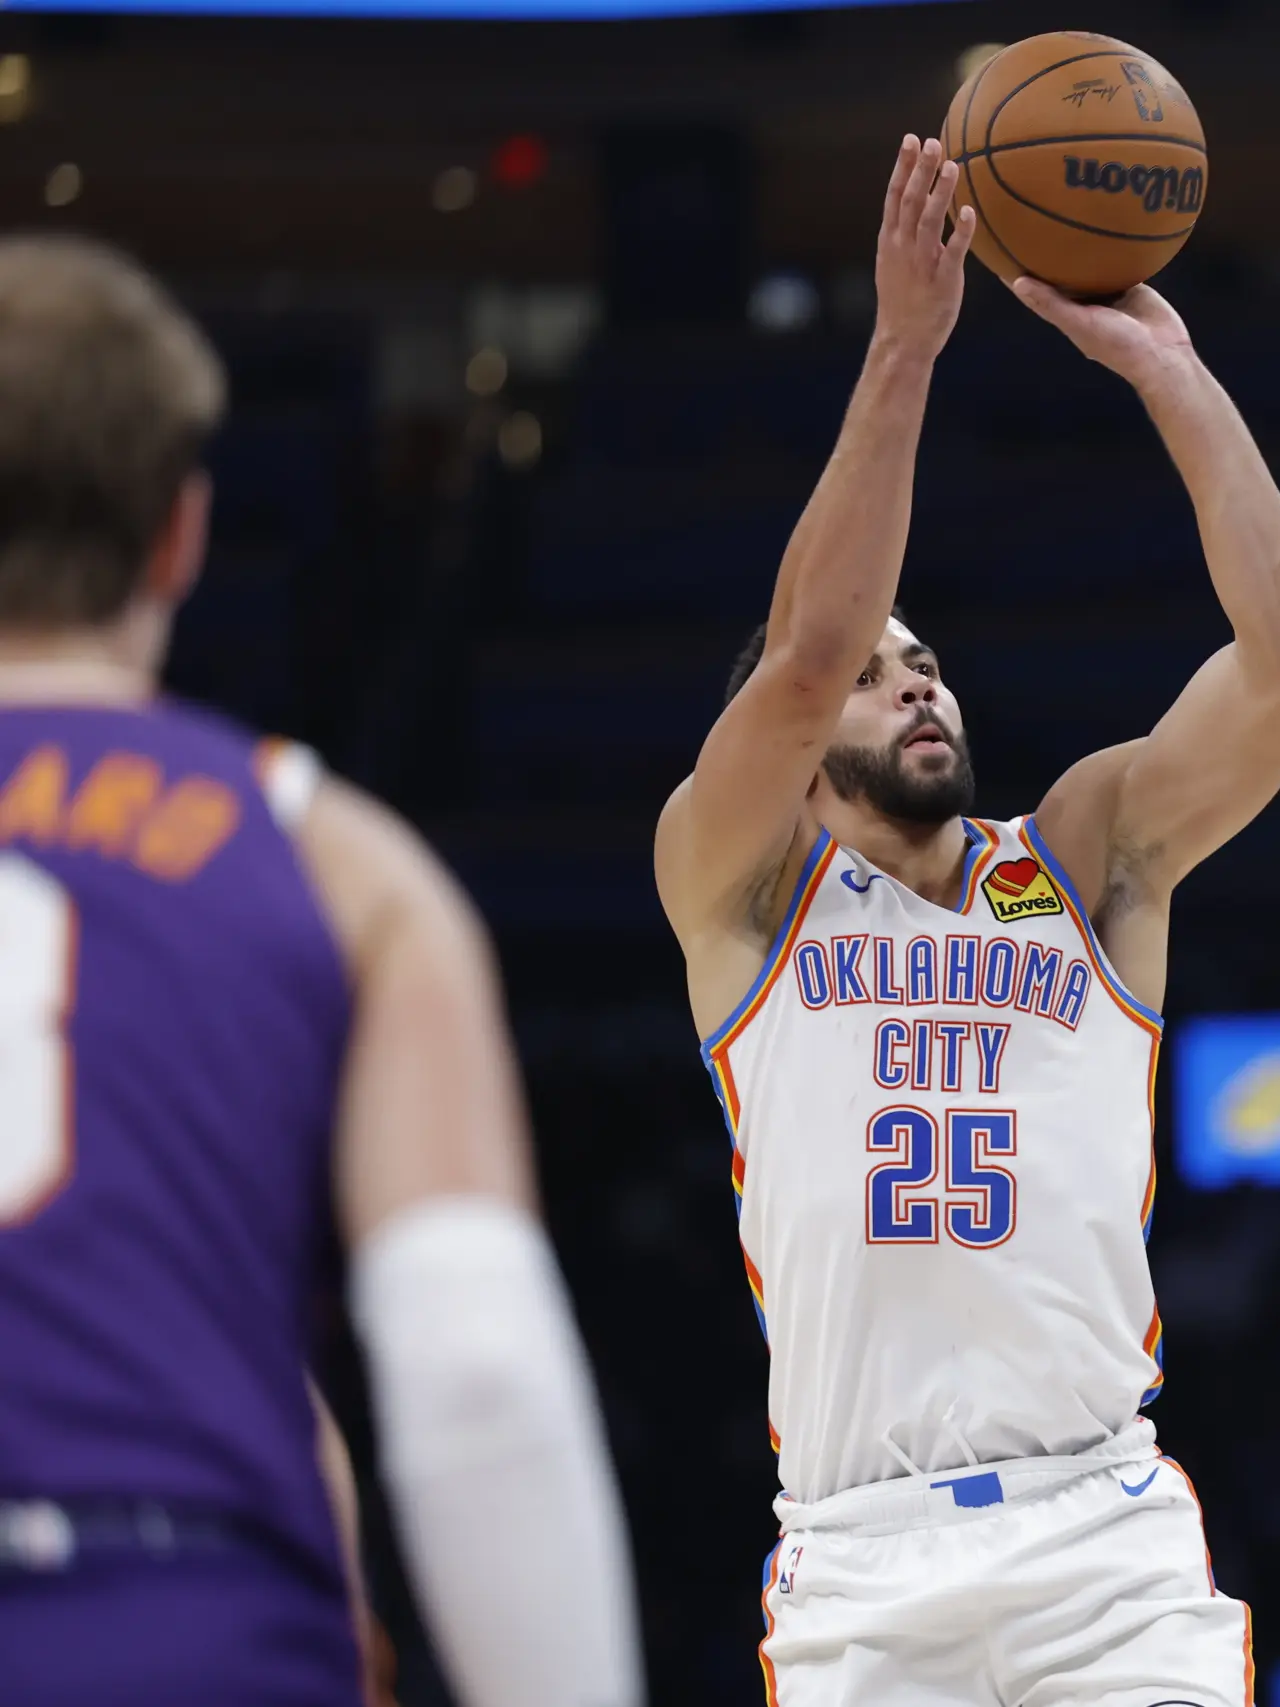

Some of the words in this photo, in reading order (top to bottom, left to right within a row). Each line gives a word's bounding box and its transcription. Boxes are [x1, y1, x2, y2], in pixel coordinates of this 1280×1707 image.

[1063, 155, 1204, 214] Wilson
[794, 933, 1092, 1032] OKLAHOMA
[873, 1018, 1011, 1093] CITY
[866, 1104, 1017, 1250] 25
